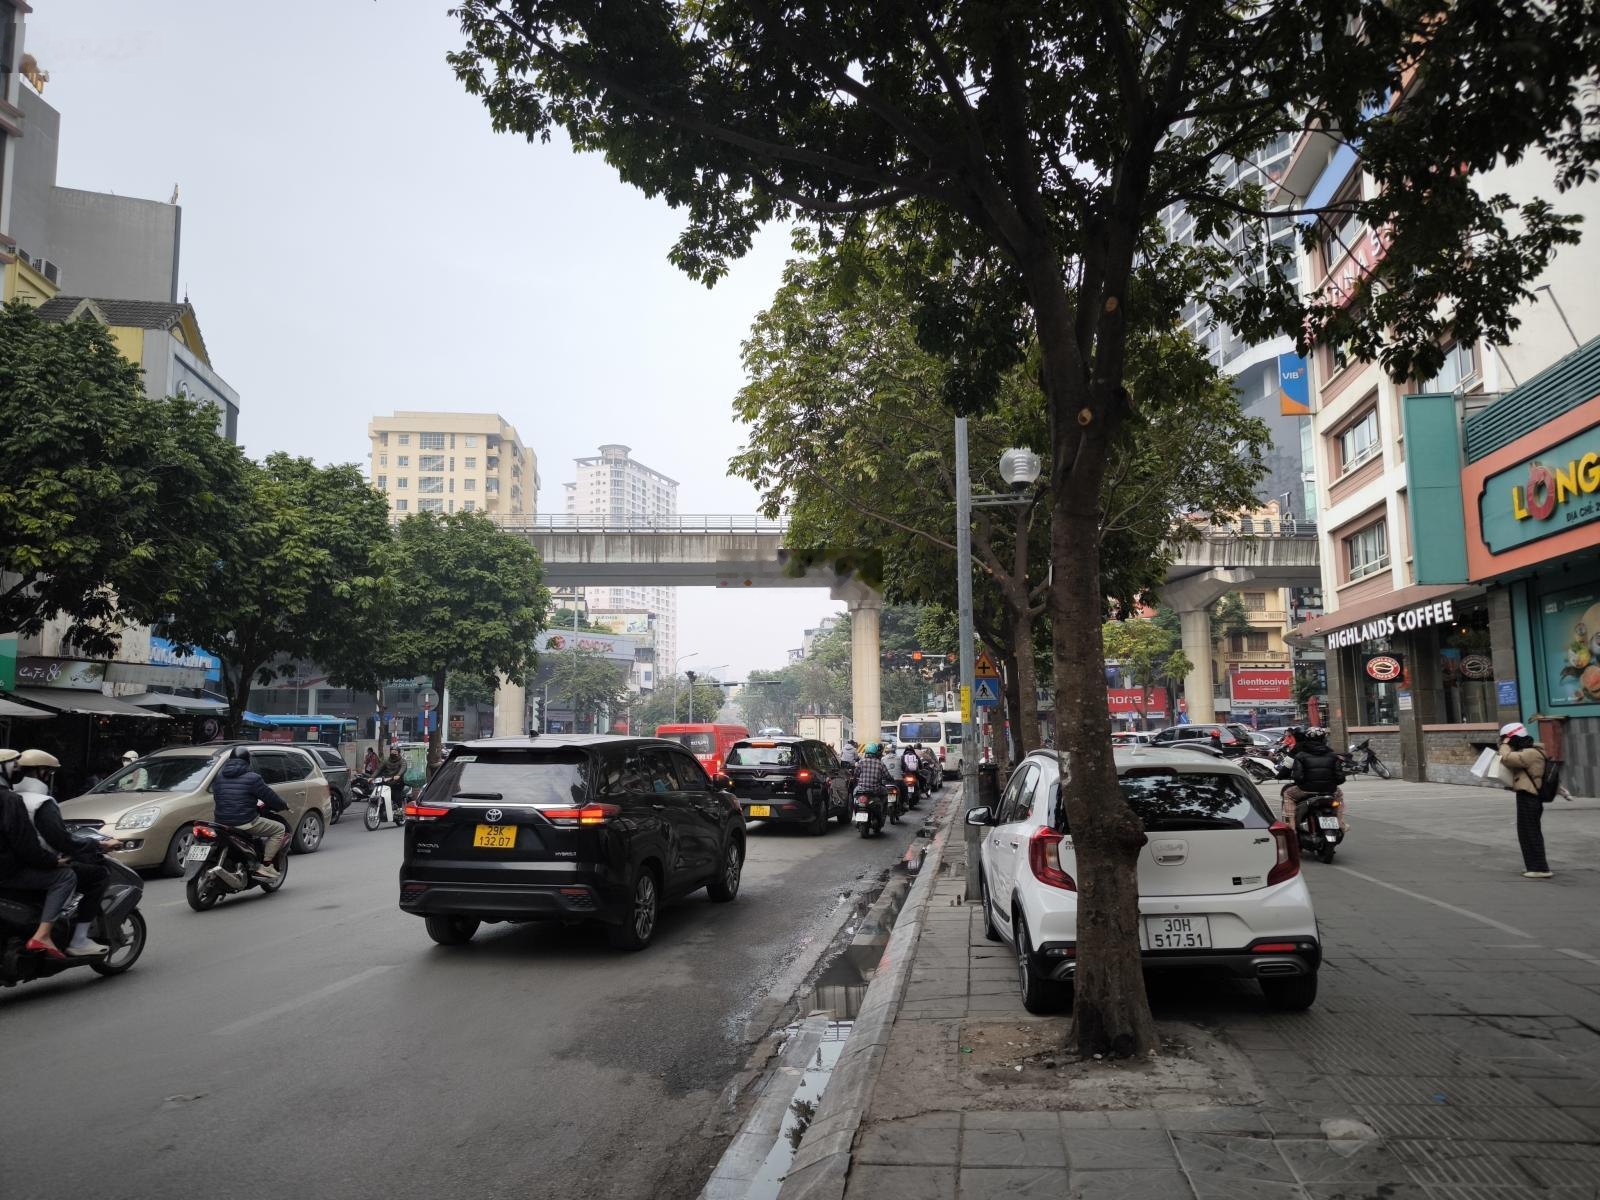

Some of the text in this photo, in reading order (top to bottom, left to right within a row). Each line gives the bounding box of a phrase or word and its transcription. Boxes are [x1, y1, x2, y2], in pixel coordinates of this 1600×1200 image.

[1282, 371, 1299, 379] VIB
[1327, 600, 1454, 650] HIGHLANDS COFFEE
[487, 825, 504, 836] 29K
[479, 836, 511, 848] 132.07
[1164, 918, 1192, 932] 30H
[1154, 932, 1203, 948] 517.51
